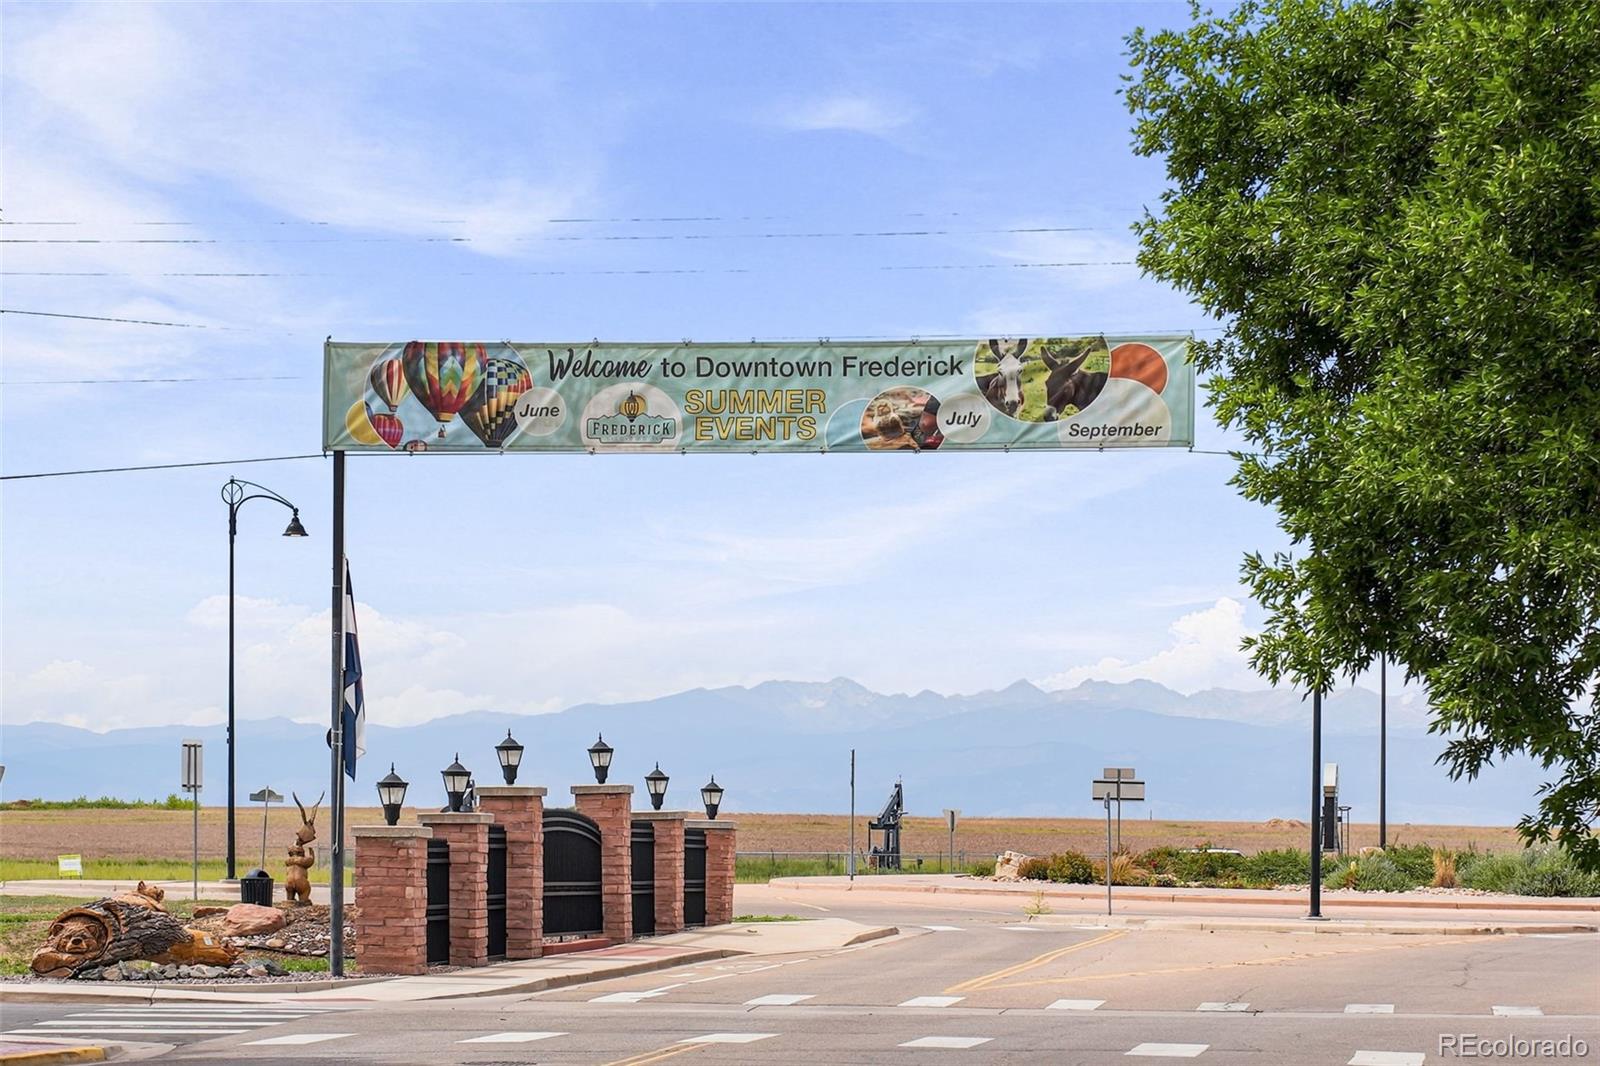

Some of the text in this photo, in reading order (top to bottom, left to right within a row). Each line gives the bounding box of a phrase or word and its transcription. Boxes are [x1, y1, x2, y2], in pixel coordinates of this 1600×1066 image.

[548, 348, 963, 381] Welcome to Downtown Frederick
[684, 389, 827, 415] SUMMER
[518, 404, 560, 418] June
[945, 411, 982, 428] July
[593, 422, 671, 436] FREDERICK
[694, 416, 817, 441] EVENTS
[1068, 423, 1163, 438] September
